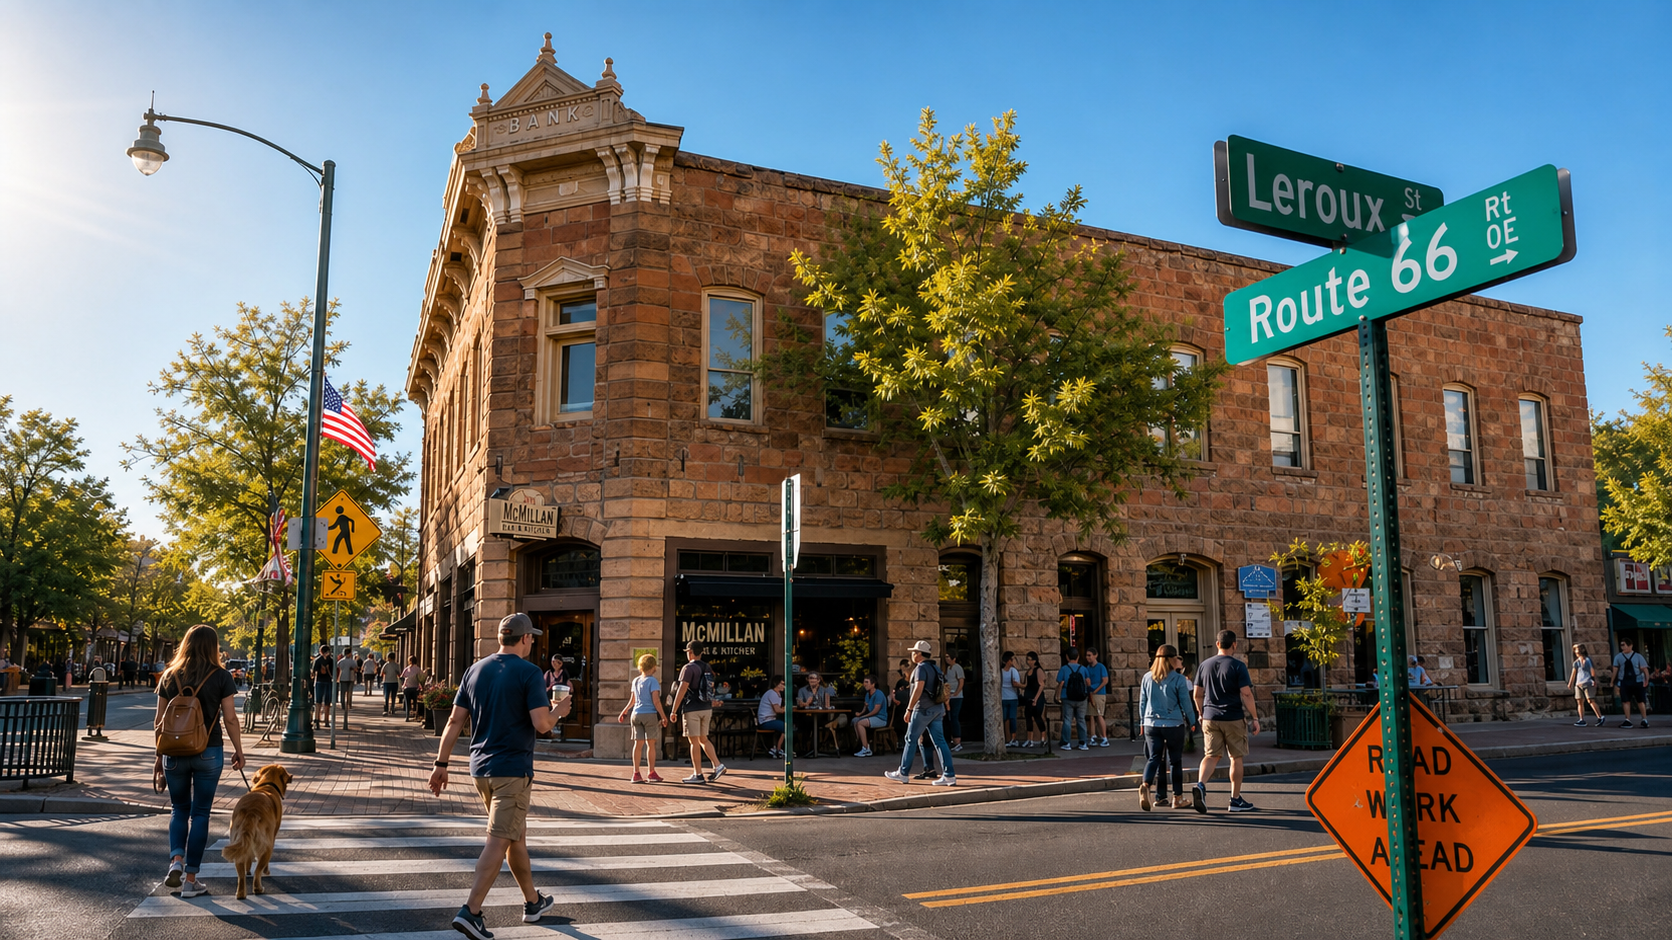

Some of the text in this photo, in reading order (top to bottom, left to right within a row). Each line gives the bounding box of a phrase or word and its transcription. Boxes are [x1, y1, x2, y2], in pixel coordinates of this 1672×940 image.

[508, 105, 580, 134] BANK
[1246, 152, 1422, 233] Leroux St
[1485, 191, 1512, 222] Rt
[1249, 222, 1458, 344] Route 66
[1367, 745, 1452, 776] RAD
[1366, 789, 1461, 824] WRK
[1370, 837, 1474, 873] AEAD
